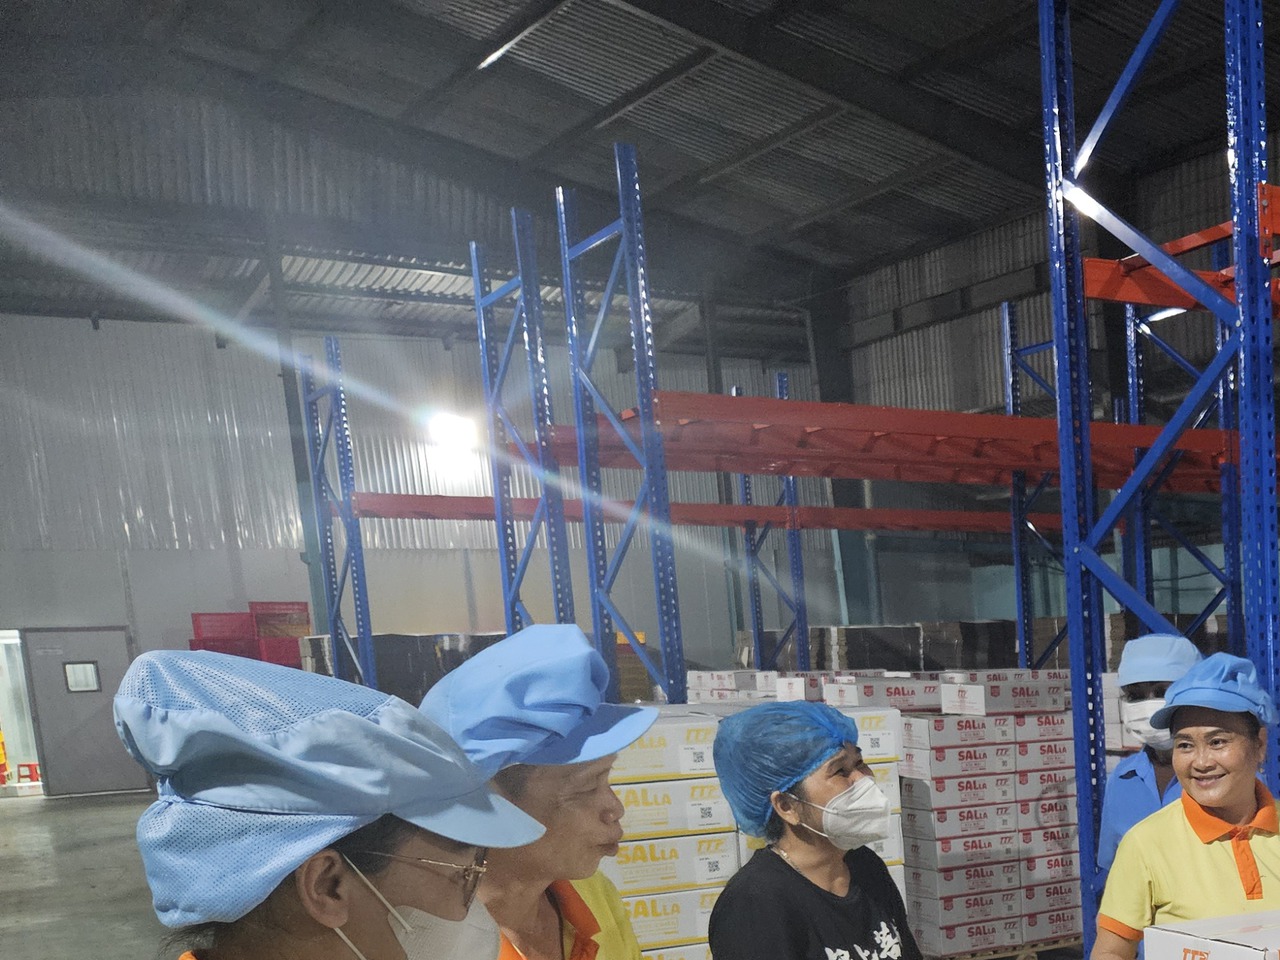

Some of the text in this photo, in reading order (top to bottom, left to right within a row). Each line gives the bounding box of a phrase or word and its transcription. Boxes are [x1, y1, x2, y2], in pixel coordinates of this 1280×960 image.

[957, 719, 986, 731] SALLA
[1037, 716, 1065, 726] SALLA
[958, 750, 988, 761] SALLA
[1039, 745, 1067, 755] SALLA
[958, 780, 987, 791] SALLA
[959, 809, 988, 821] SALLA
[963, 839, 992, 851] SALLA
[616, 843, 679, 865] SALLA
[965, 867, 994, 879] SALLA
[967, 926, 996, 937] SALLA
